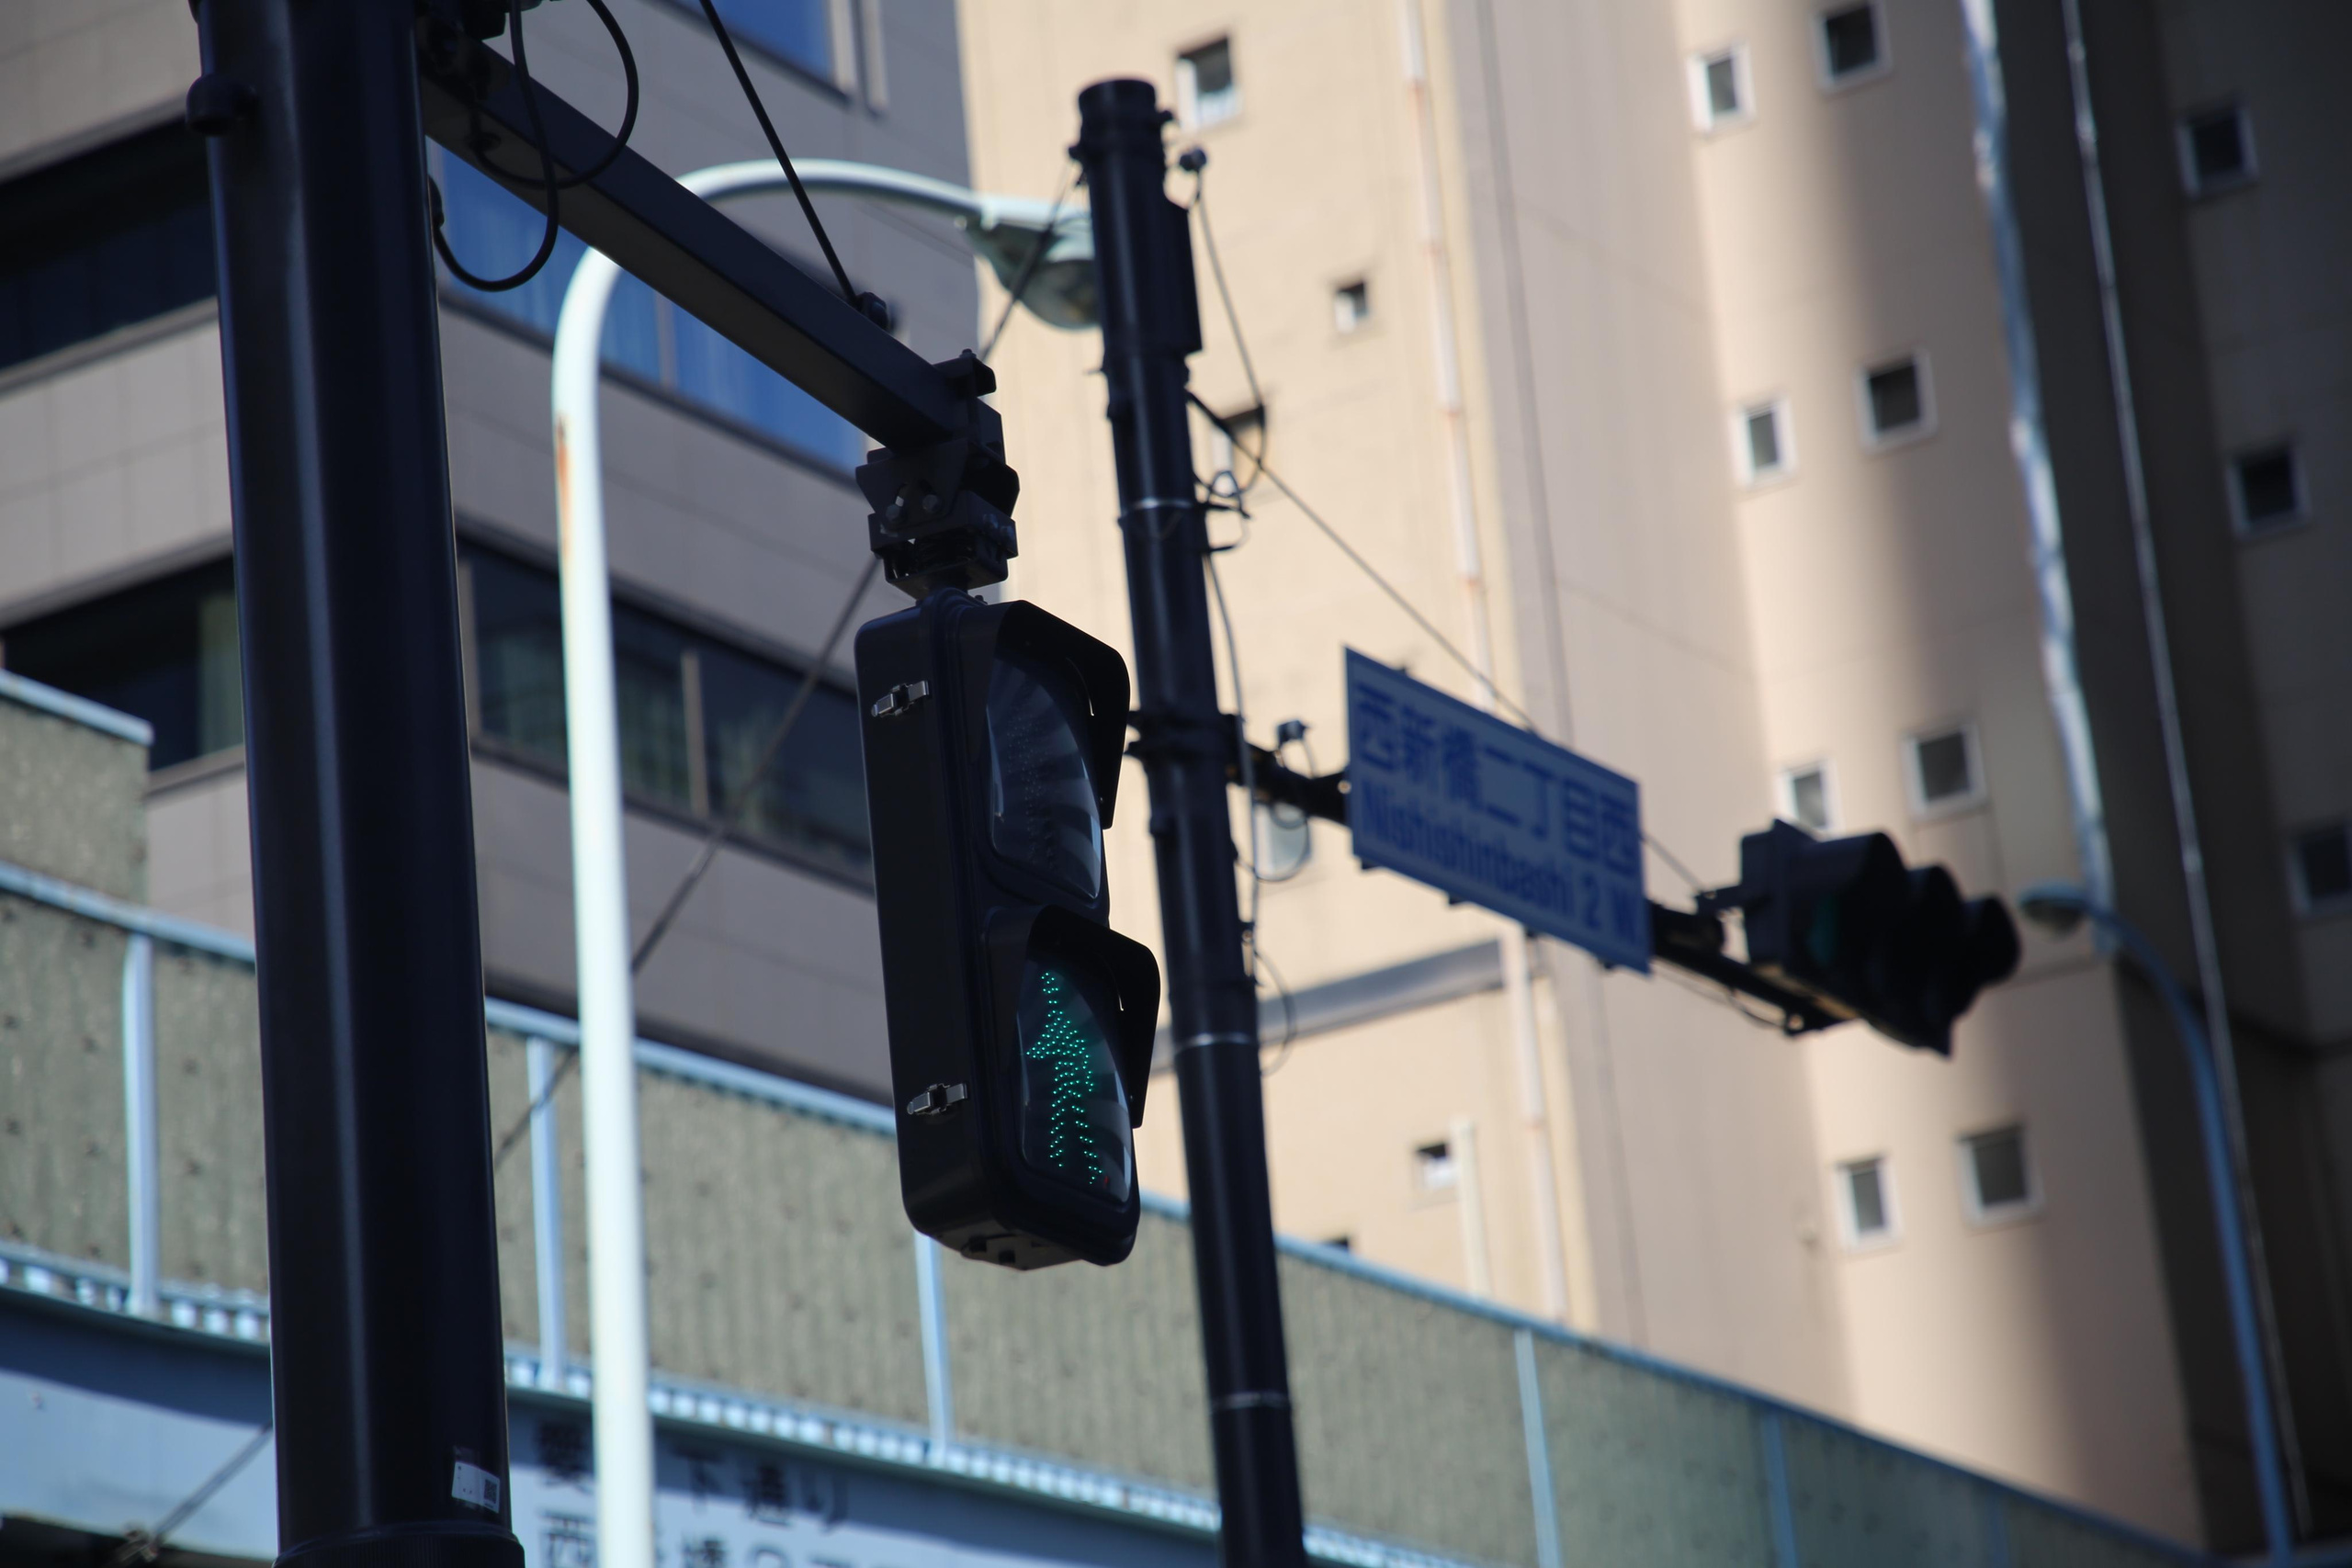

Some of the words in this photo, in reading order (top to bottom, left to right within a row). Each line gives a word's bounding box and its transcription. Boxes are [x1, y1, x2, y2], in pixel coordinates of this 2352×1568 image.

[1357, 683, 1638, 874] 西新橋二丁目西
[1363, 779, 1572, 918] Nishishinbashi
[1581, 874, 1602, 931] 2
